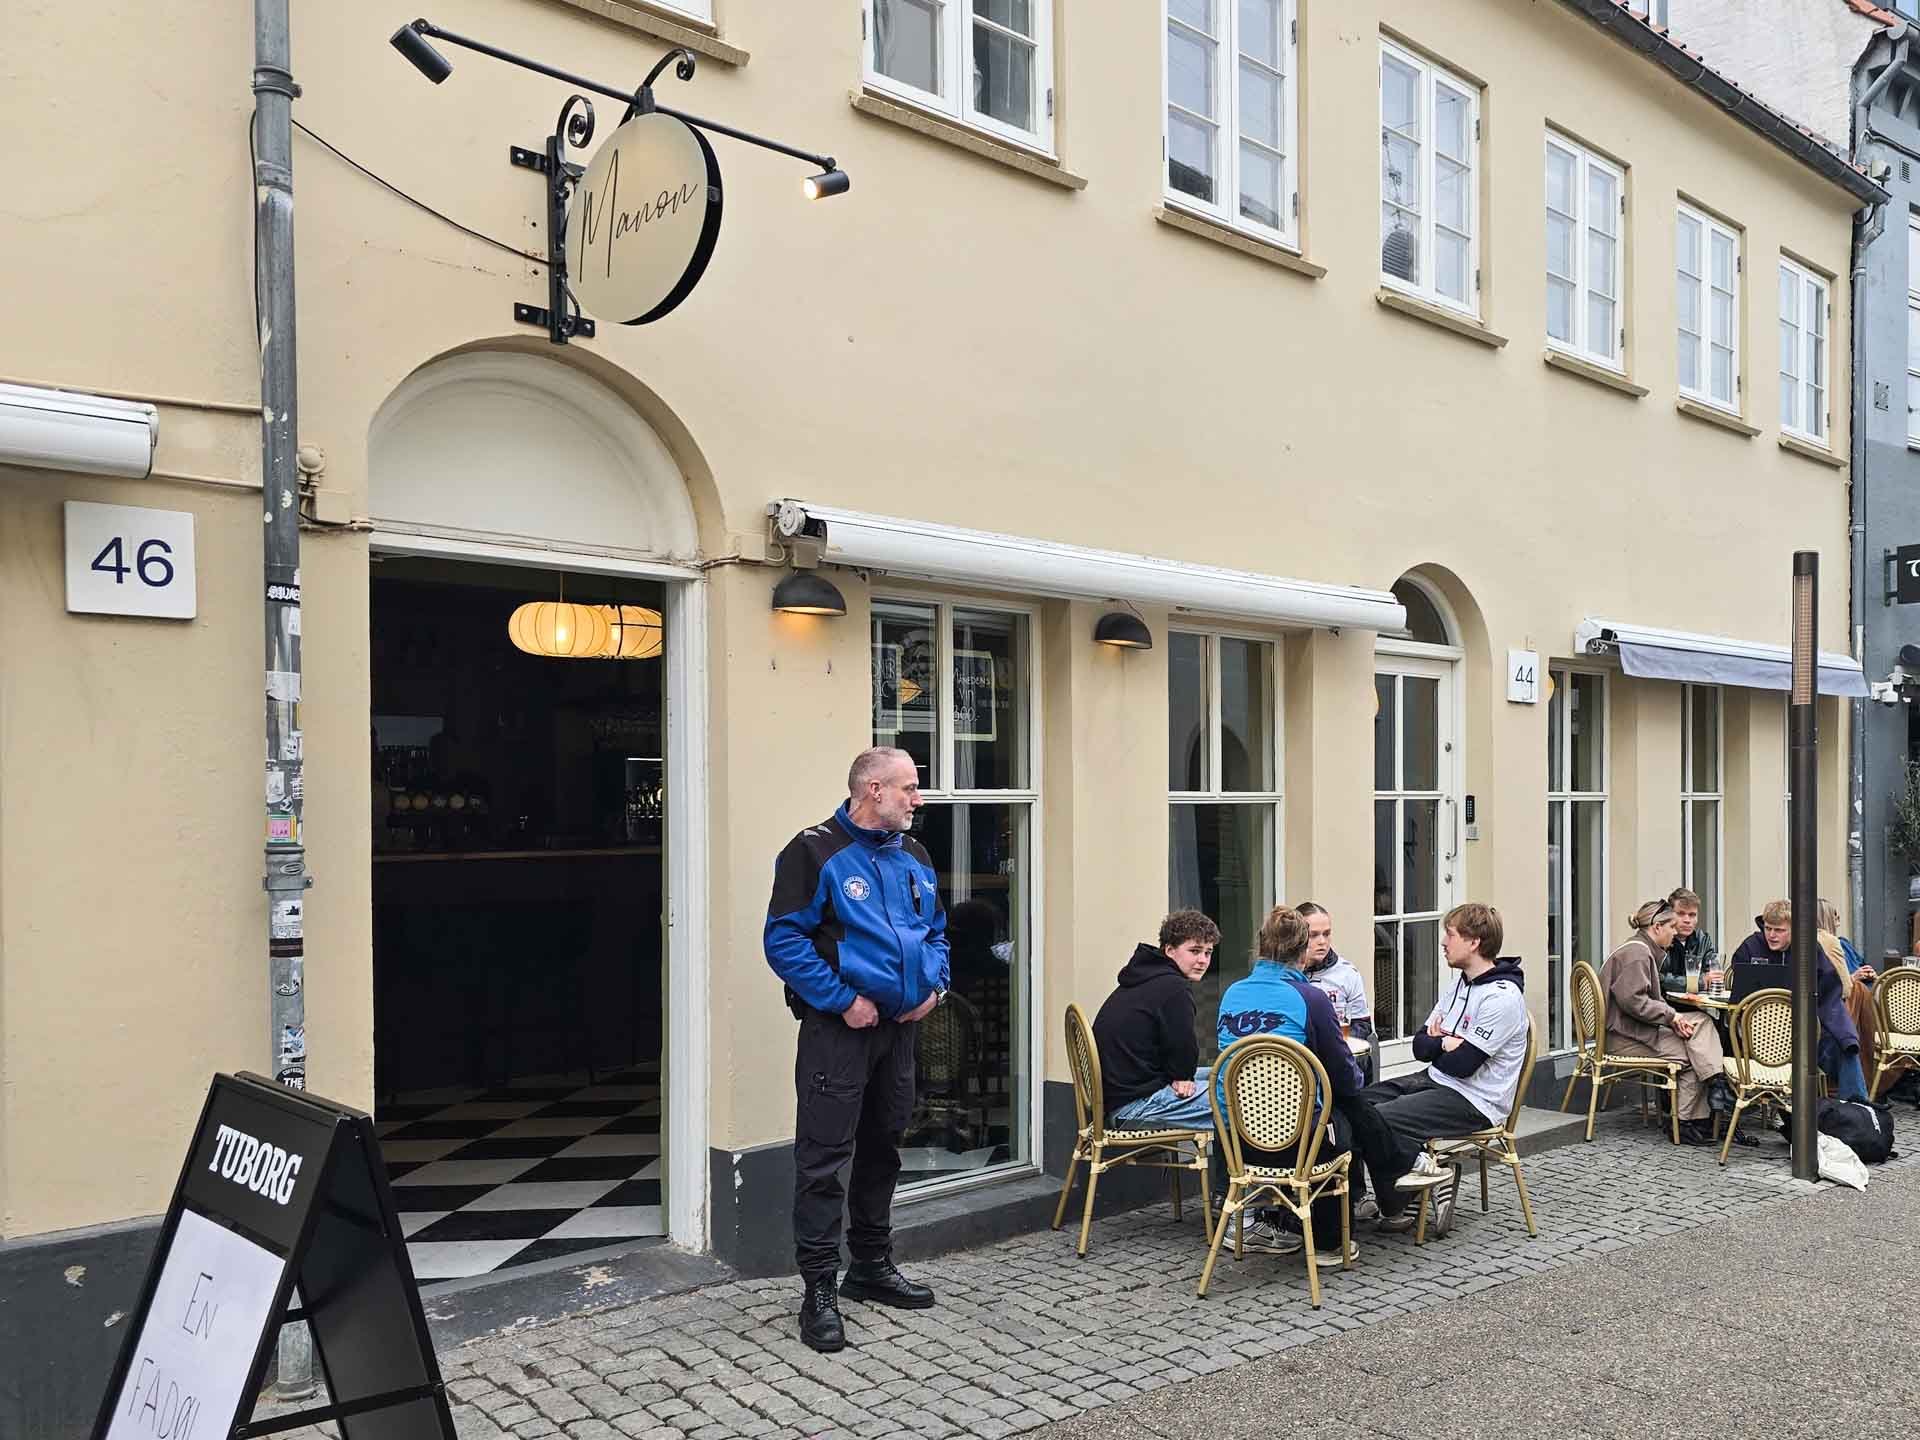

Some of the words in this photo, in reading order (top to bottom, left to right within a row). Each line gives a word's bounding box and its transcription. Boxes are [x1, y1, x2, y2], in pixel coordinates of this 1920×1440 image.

[579, 148, 698, 283] Manon
[91, 536, 174, 587] 46
[1515, 664, 1534, 687] 44
[208, 1124, 303, 1205] TUBORG
[182, 1271, 219, 1340] EN
